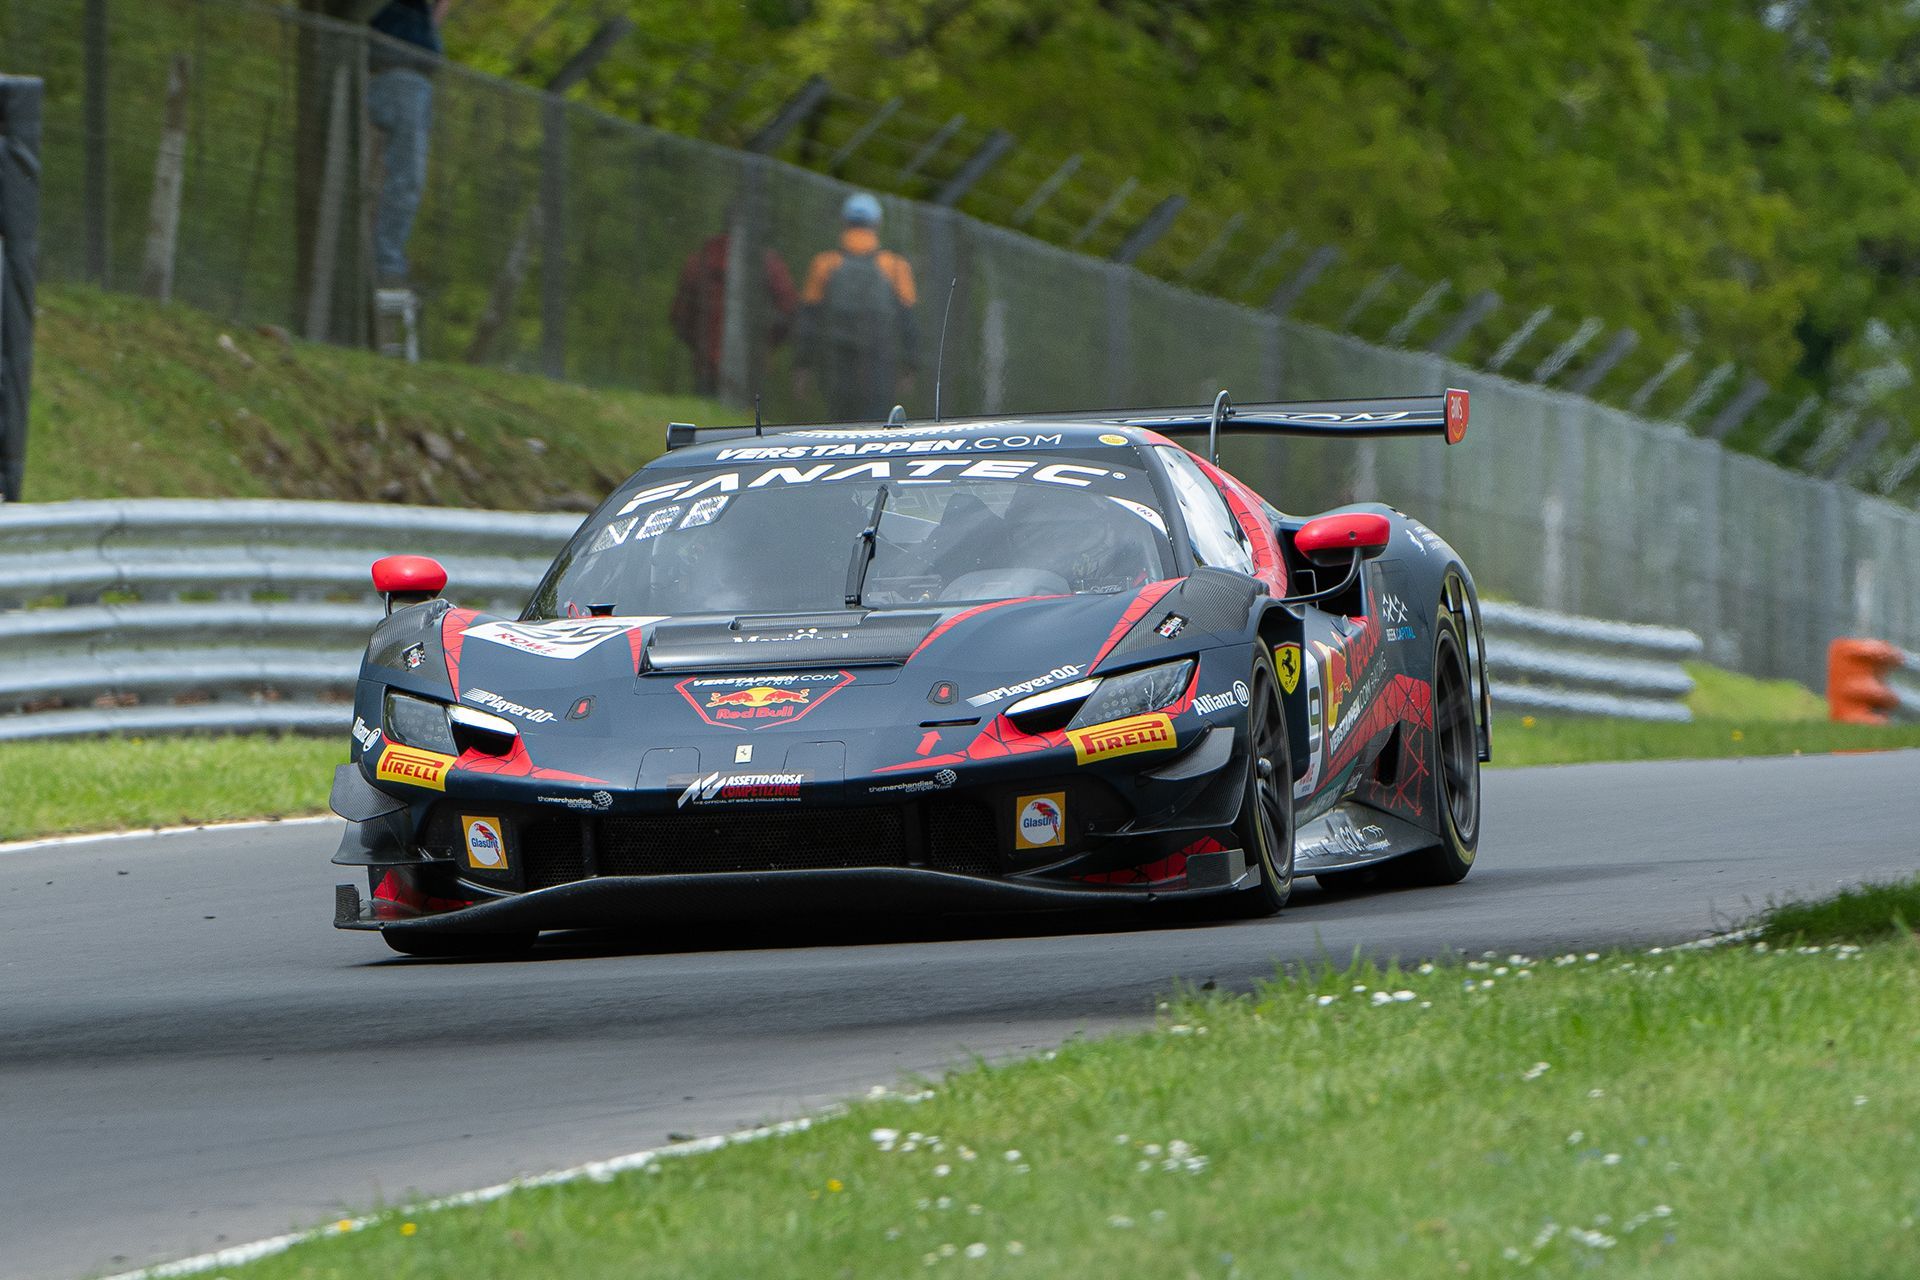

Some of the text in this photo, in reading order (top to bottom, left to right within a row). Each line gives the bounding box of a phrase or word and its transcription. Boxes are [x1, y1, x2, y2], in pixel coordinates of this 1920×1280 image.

[716, 434, 1062, 461] VERSTAPPEN.COM
[616, 460, 1111, 516] FANATEC
[694, 674, 839, 687] VERSTAPPEN.COM
[715, 705, 794, 719] Red Bull
[1191, 690, 1238, 716] Allianz
[1079, 720, 1168, 756] PIRELLI
[381, 751, 445, 783] PIRELLI
[721, 784, 800, 798] COMPETIZIONE
